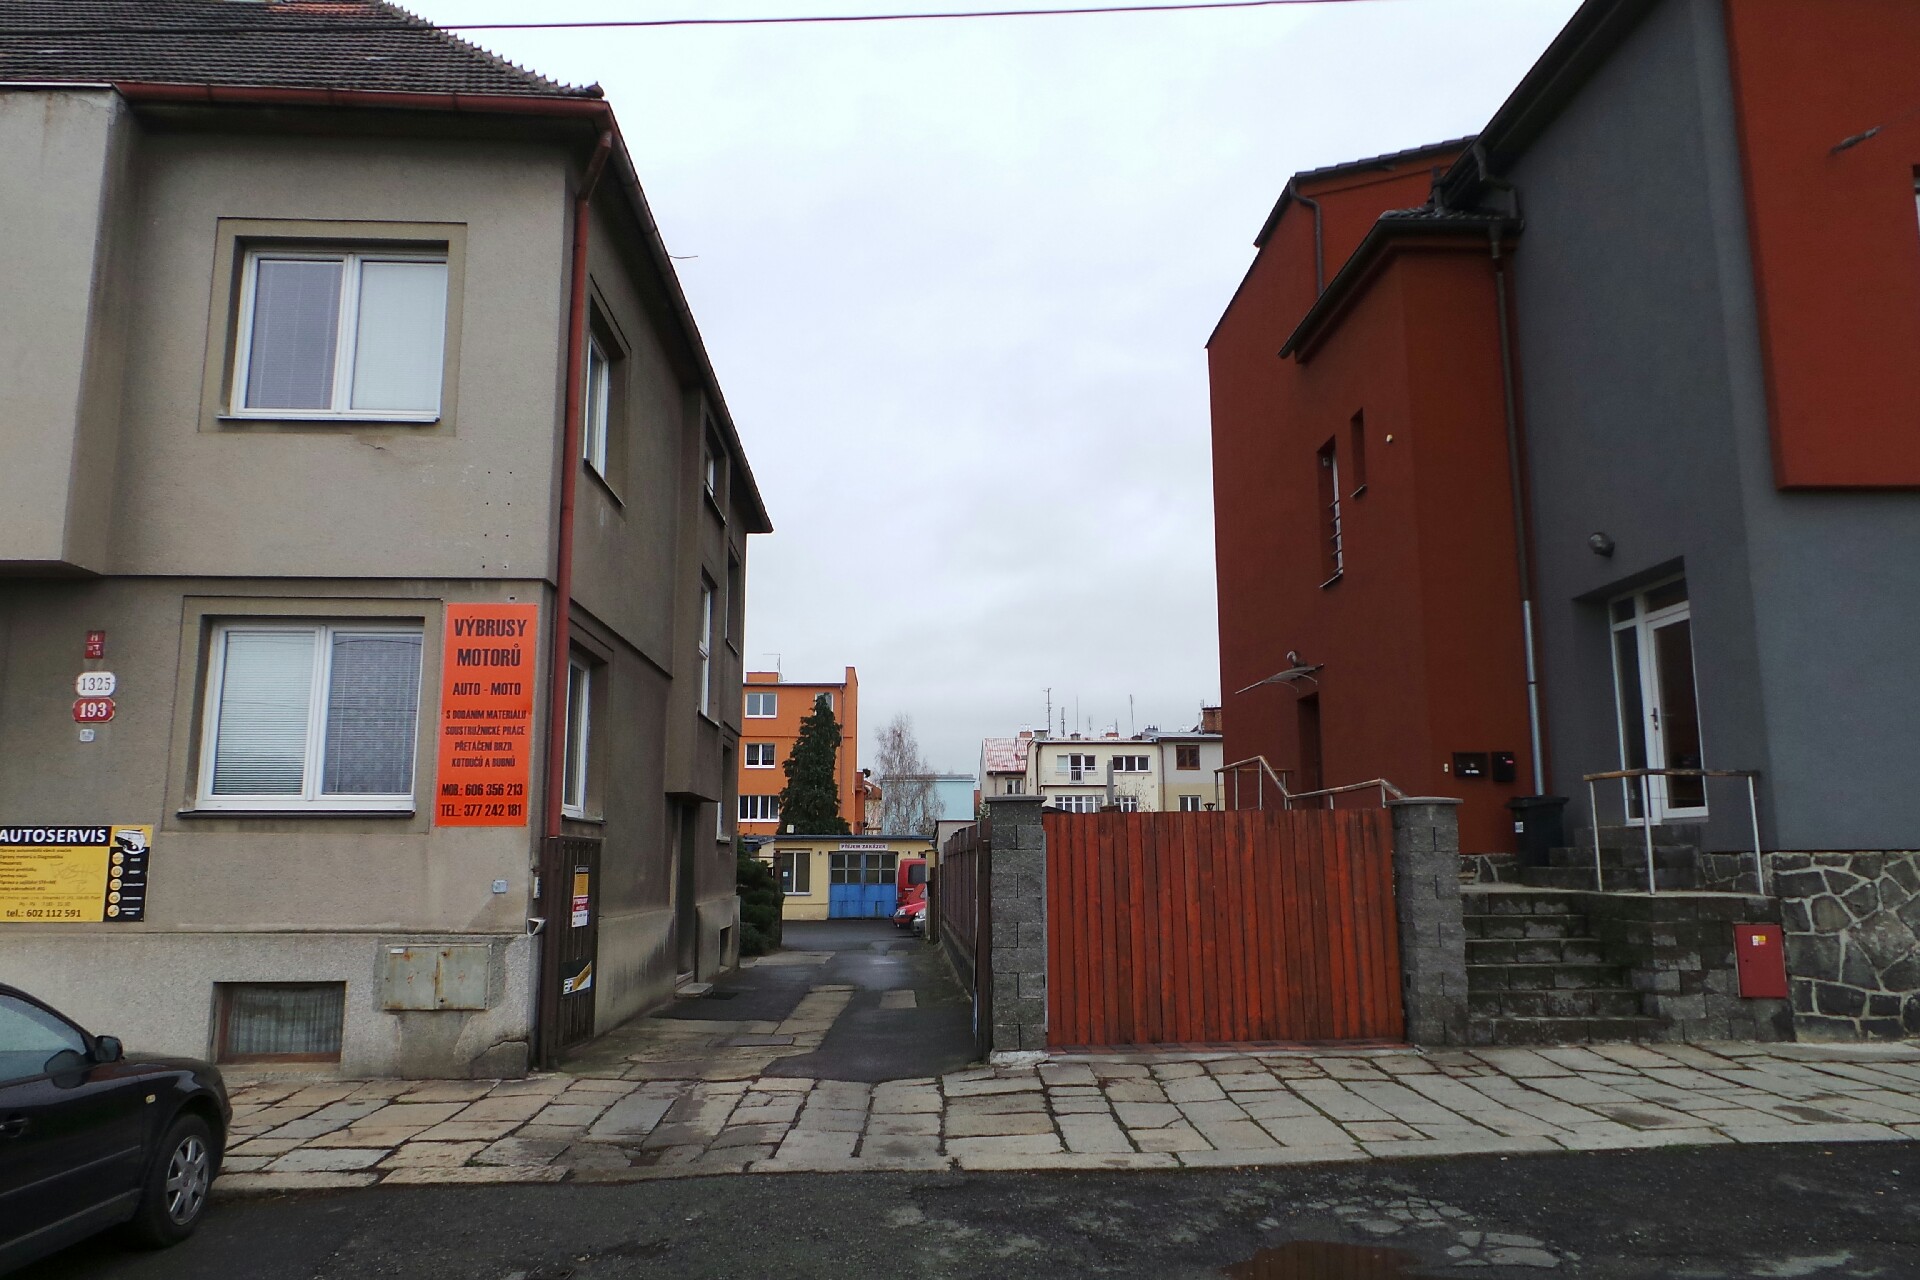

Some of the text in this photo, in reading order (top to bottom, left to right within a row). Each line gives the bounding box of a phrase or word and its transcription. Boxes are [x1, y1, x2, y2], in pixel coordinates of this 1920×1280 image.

[454, 616, 527, 637] VÝBRUSY
[456, 643, 521, 667] MOTORŮ
[82, 677, 111, 691] 1325
[452, 682, 481, 696] AUTO
[490, 682, 521, 696] MOTO
[80, 702, 107, 718] 193
[446, 709, 451, 719] S
[502, 725, 526, 735] PRÁCE
[484, 757, 491, 767] A
[441, 783, 523, 796] MOB.: 606 356 213
[440, 804, 522, 817] TEL.: 377 242 181
[0, 829, 106, 843] AUTOSERVIS
[26, 909, 43, 918] 602
[46, 909, 62, 918] 112
[64, 909, 81, 918] 591
